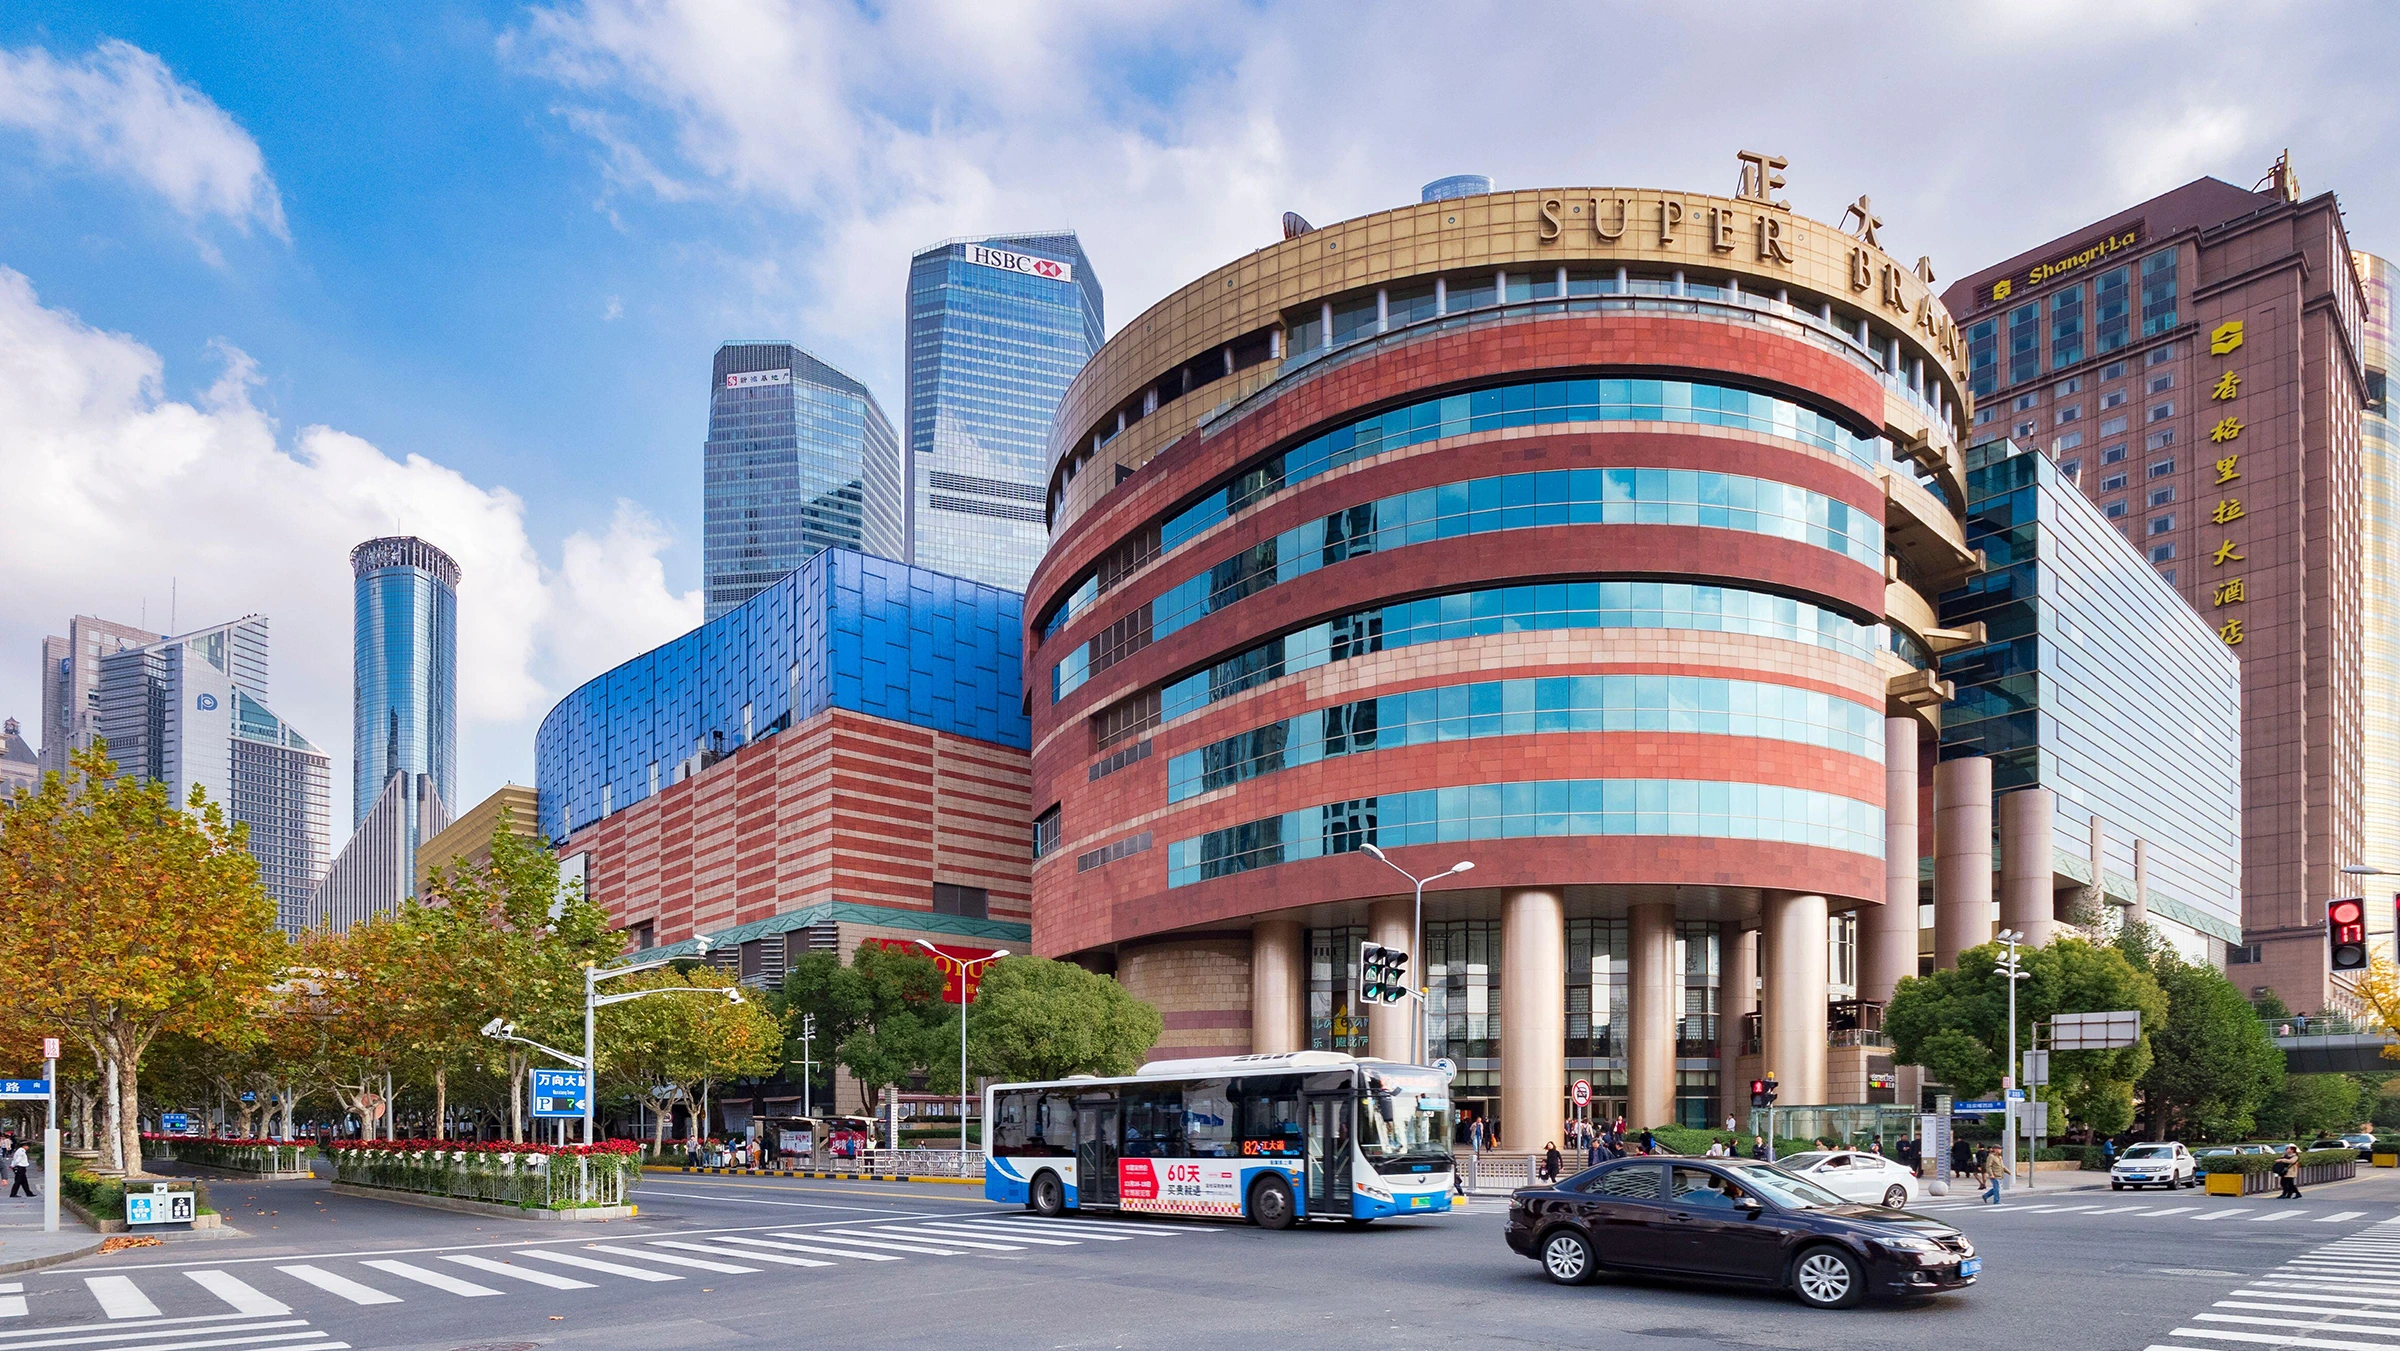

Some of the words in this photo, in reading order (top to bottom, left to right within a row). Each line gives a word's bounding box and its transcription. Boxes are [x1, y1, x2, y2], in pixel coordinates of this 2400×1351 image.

[974, 246, 1032, 273] HSBC
[2028, 231, 2136, 286] Shangri-La
[1539, 196, 1795, 265] SUPER
[1850, 246, 1971, 384] BRAND
[2210, 370, 2246, 646] 香格里拉大酒店
[2342, 924, 2362, 942] 17
[1168, 1165, 1200, 1183] 60天
